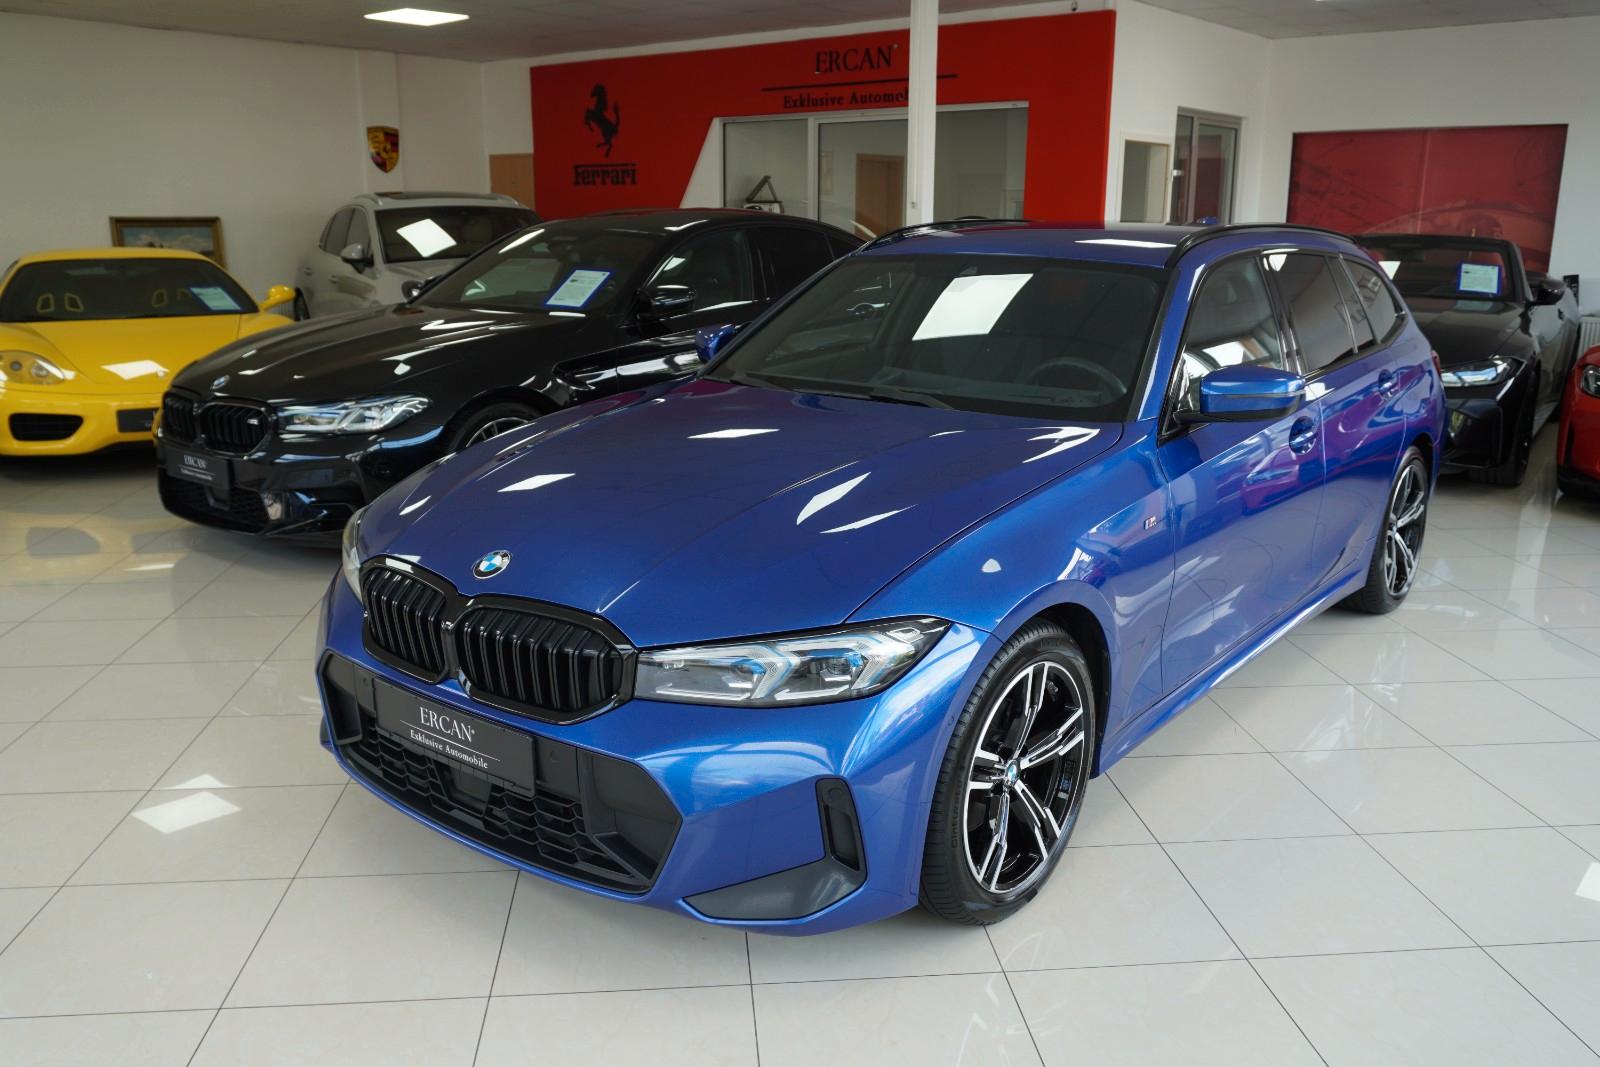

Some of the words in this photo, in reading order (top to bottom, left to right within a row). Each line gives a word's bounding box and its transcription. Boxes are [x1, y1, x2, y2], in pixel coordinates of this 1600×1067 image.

[815, 46, 893, 73] ERCAN
[784, 92, 844, 109] Exklusive
[849, 87, 909, 105] Automo
[573, 163, 637, 186] Ferrari
[420, 706, 472, 742] ERCAN
[410, 729, 443, 751] Exklusive
[445, 744, 489, 769] Automobile
